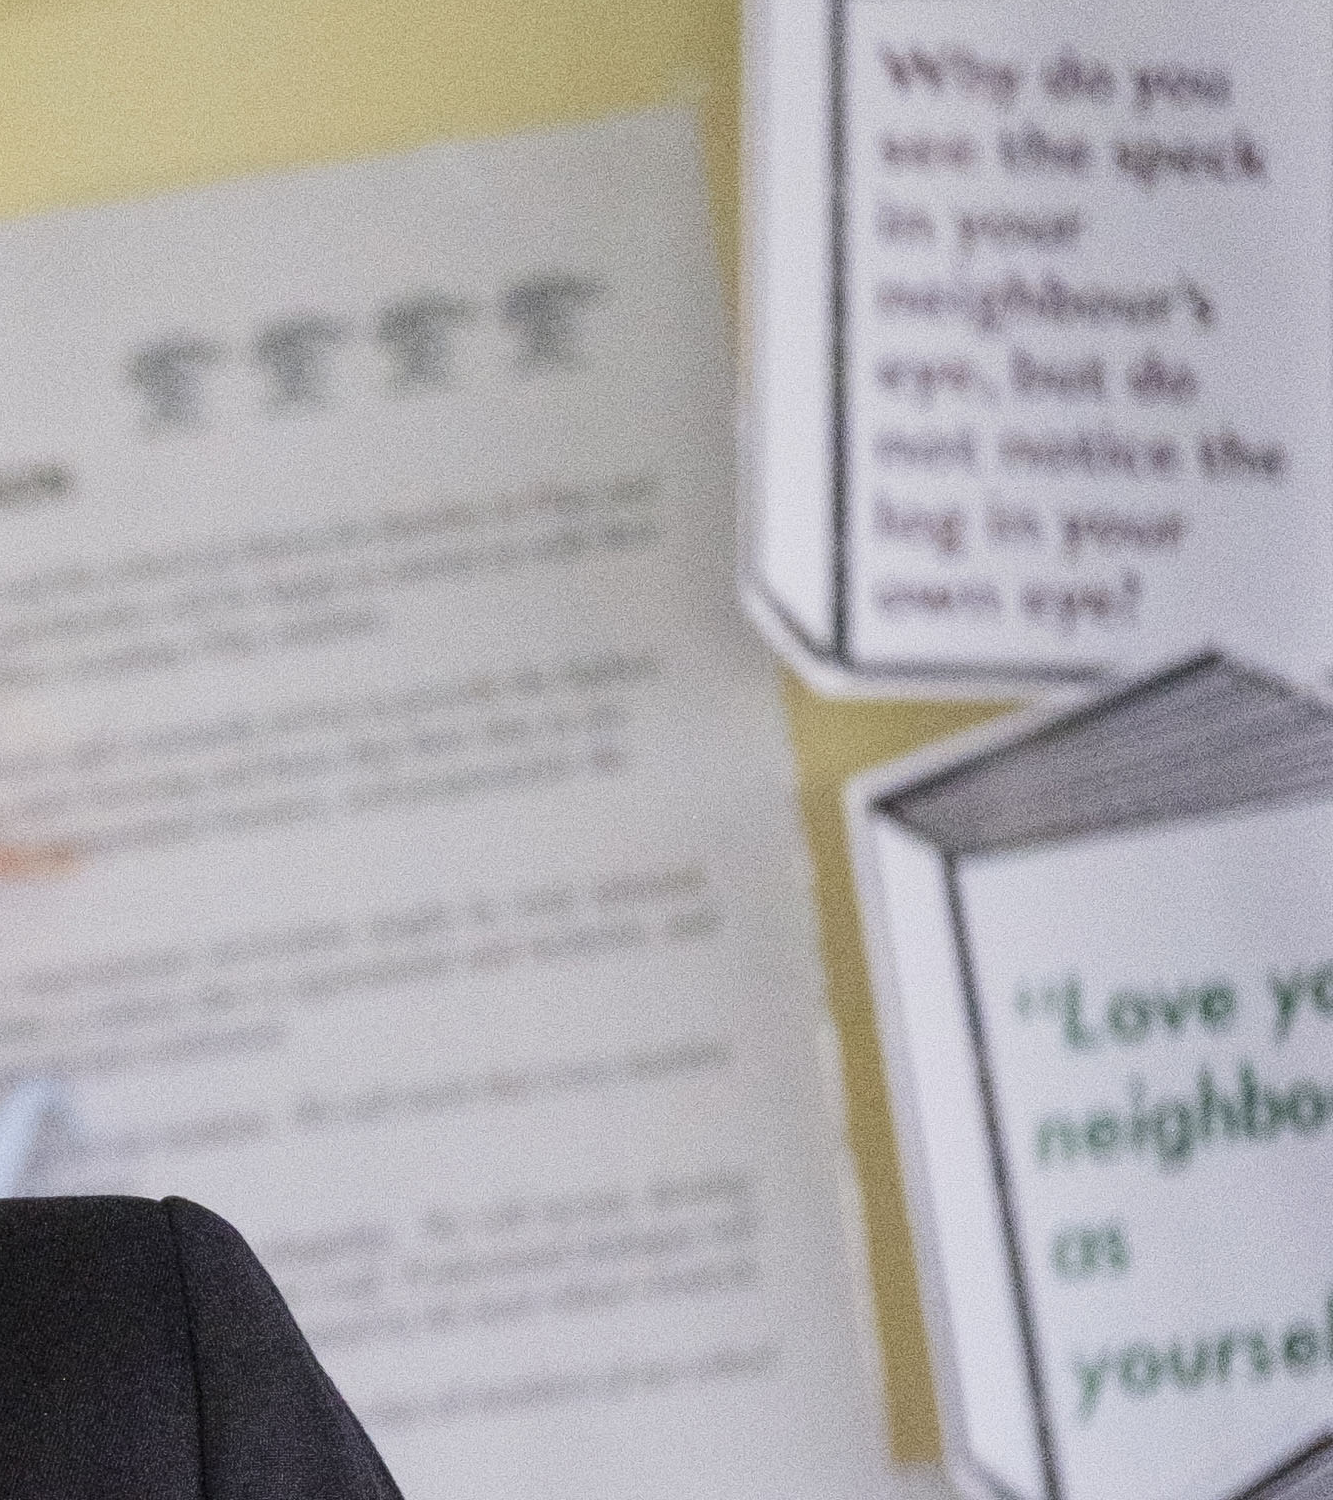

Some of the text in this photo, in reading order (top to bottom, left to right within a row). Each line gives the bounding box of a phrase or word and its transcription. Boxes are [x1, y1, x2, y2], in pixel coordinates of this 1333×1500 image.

[881, 43, 1233, 112] Why do you
[880, 121, 1269, 190] see the speck
[878, 203, 1085, 260] in your
[1010, 347, 1105, 402] but
[1126, 350, 1199, 402] do
[876, 427, 1288, 484] not notice the
[876, 497, 1186, 562] log in your
[878, 580, 1001, 618] own
[1051, 1220, 1132, 1284] as
